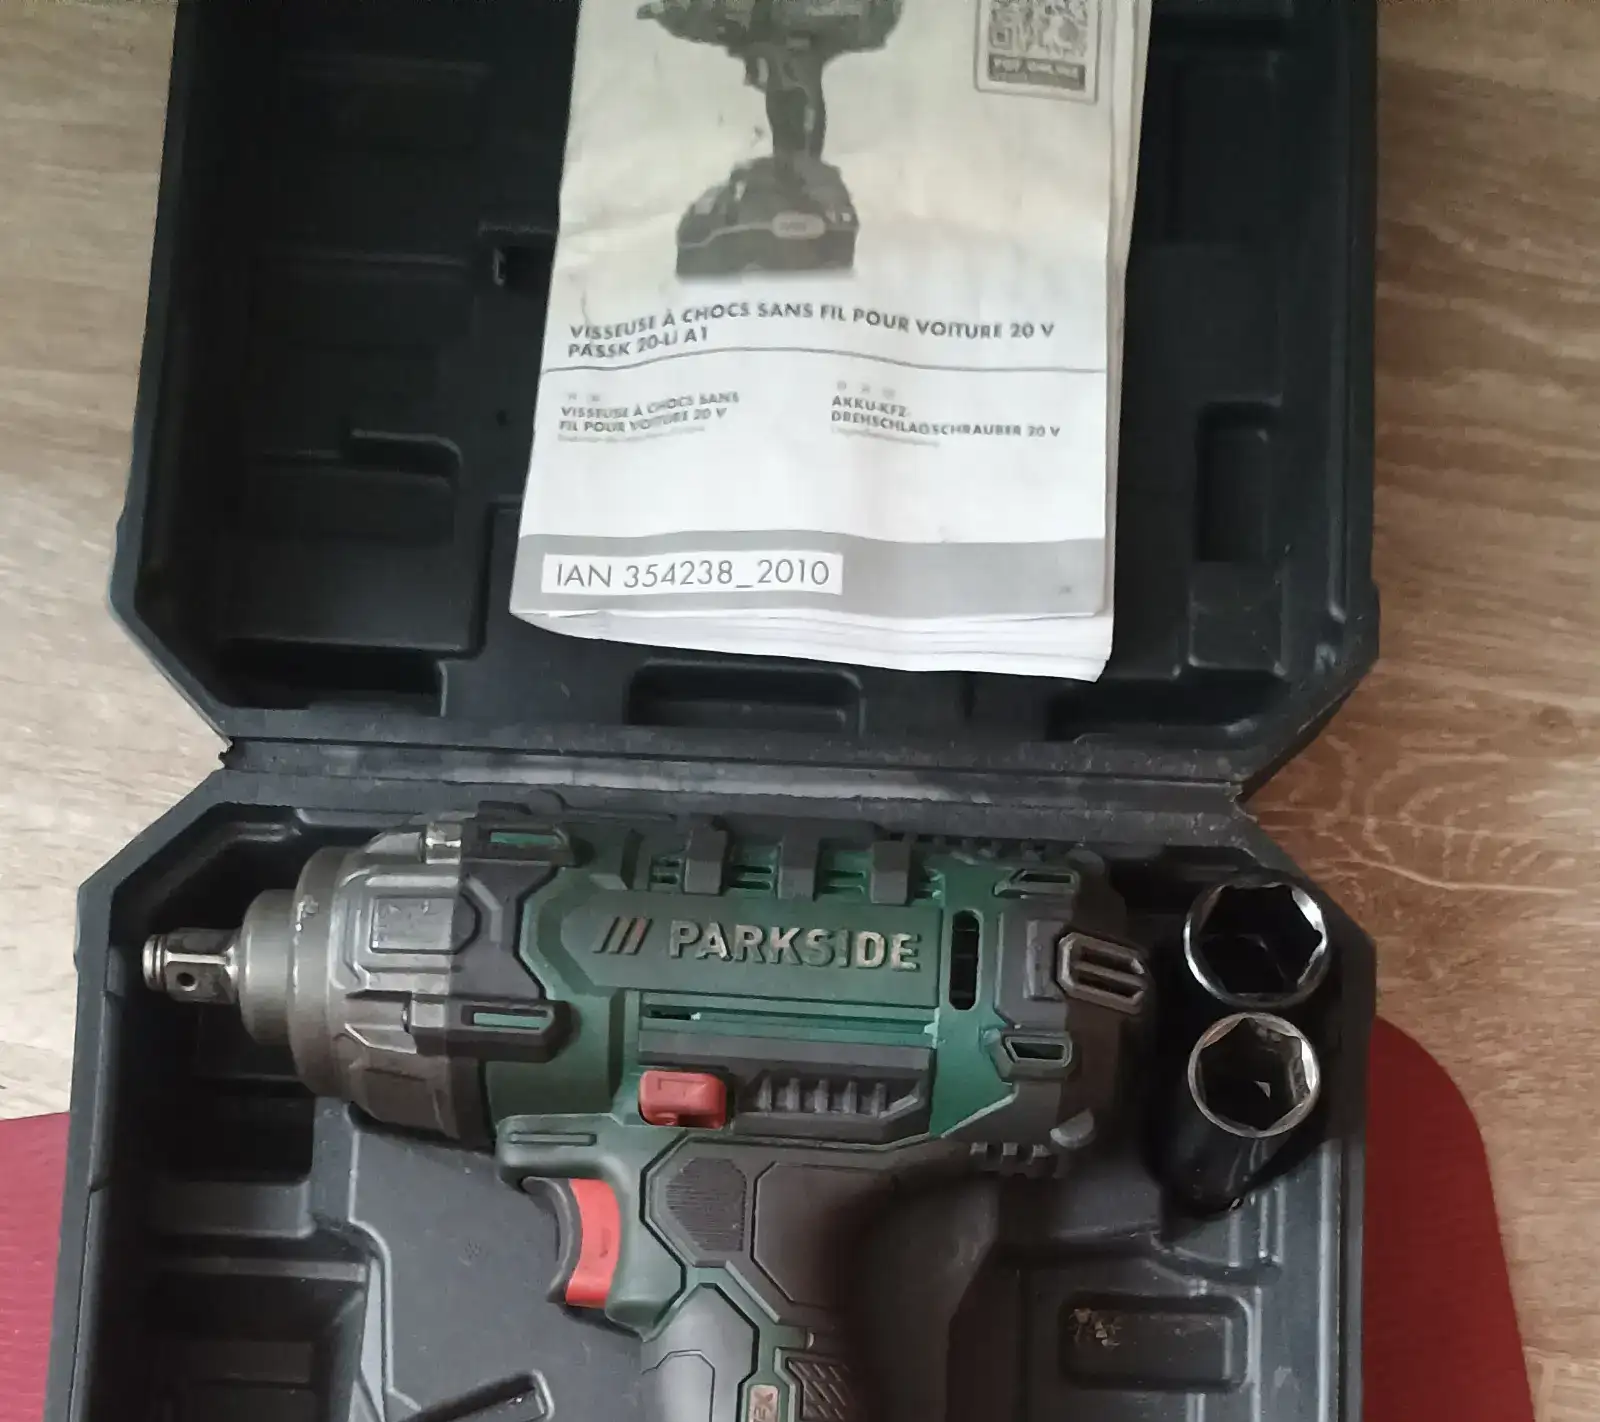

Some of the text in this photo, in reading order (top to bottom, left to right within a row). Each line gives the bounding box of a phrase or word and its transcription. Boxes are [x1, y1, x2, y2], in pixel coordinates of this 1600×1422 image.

[569, 302, 1054, 340] VISSEUSE À CHOCS SANS FIL POUR VOITURE 20 V
[568, 339, 630, 359] PASSK
[684, 325, 708, 344] A1
[584, 421, 625, 433] POUR
[693, 408, 711, 421] 20
[716, 407, 727, 419] V
[1027, 424, 1045, 438] 20
[1050, 426, 1060, 438] V
[557, 558, 830, 588] IAN 354238_2010
[669, 919, 921, 972] PARKSIDE
